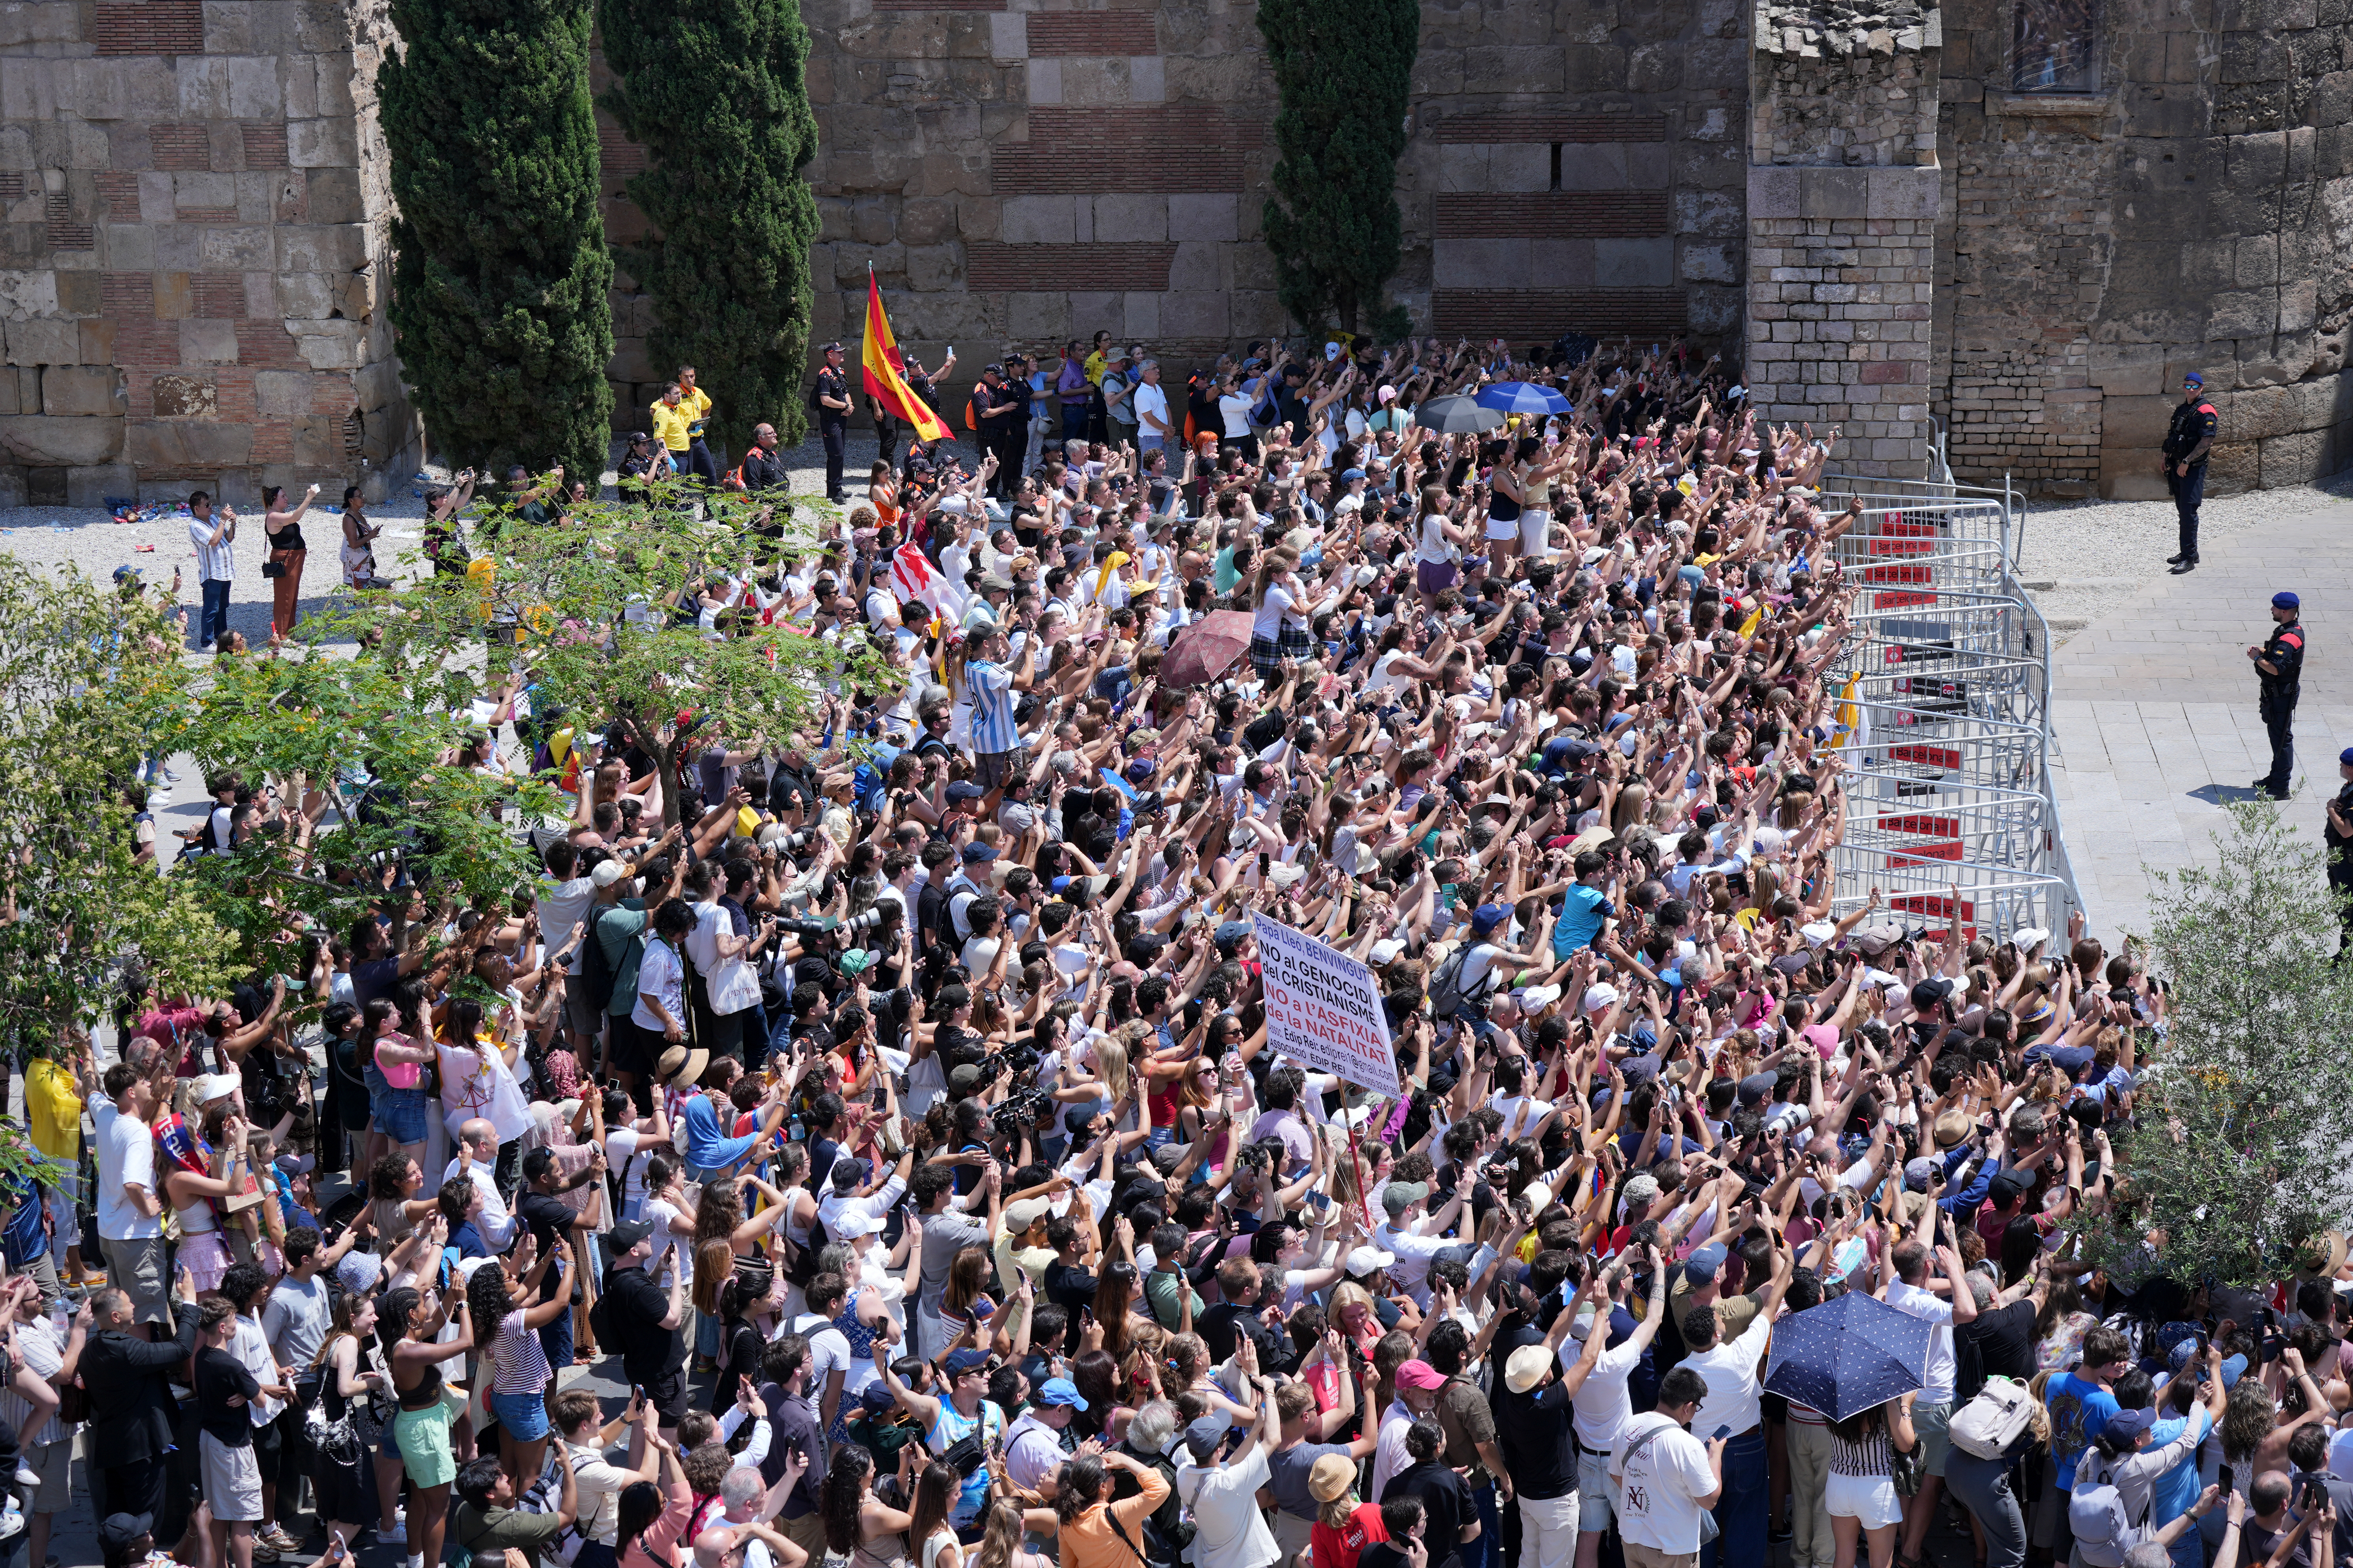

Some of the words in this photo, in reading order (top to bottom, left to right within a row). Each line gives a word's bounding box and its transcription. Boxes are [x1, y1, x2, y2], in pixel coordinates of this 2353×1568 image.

[880, 384, 898, 399] CRIST
[1255, 916, 1280, 941] Papa
[1281, 928, 1305, 957] Lleó,
[1305, 942, 1367, 984] BENVINGUT
[727, 989, 741, 999] LADY
[742, 986, 756, 995] PIPA
[1260, 939, 1281, 963] NO
[1285, 955, 1296, 969] al
[1299, 962, 1373, 1009] GENOCIDI
[1263, 962, 1279, 981] del
[1282, 971, 1377, 1027] CRISTIANISME
[1266, 981, 1288, 1005] NO
[1293, 999, 1302, 1012] a
[1268, 1003, 1284, 1021] de
[1287, 1011, 1301, 1029] la
[1306, 1019, 1386, 1065] NATALITAT
[1270, 1038, 1306, 1060] ASSOCIACIÓ
[1310, 1052, 1329, 1067] ÈDIP
[1331, 1061, 1346, 1075] REI
[1320, 1043, 1396, 1083] ediprei1@gmail.com
[1347, 1529, 1362, 1544] HELLO
[1351, 1534, 1364, 1548] KITTY
